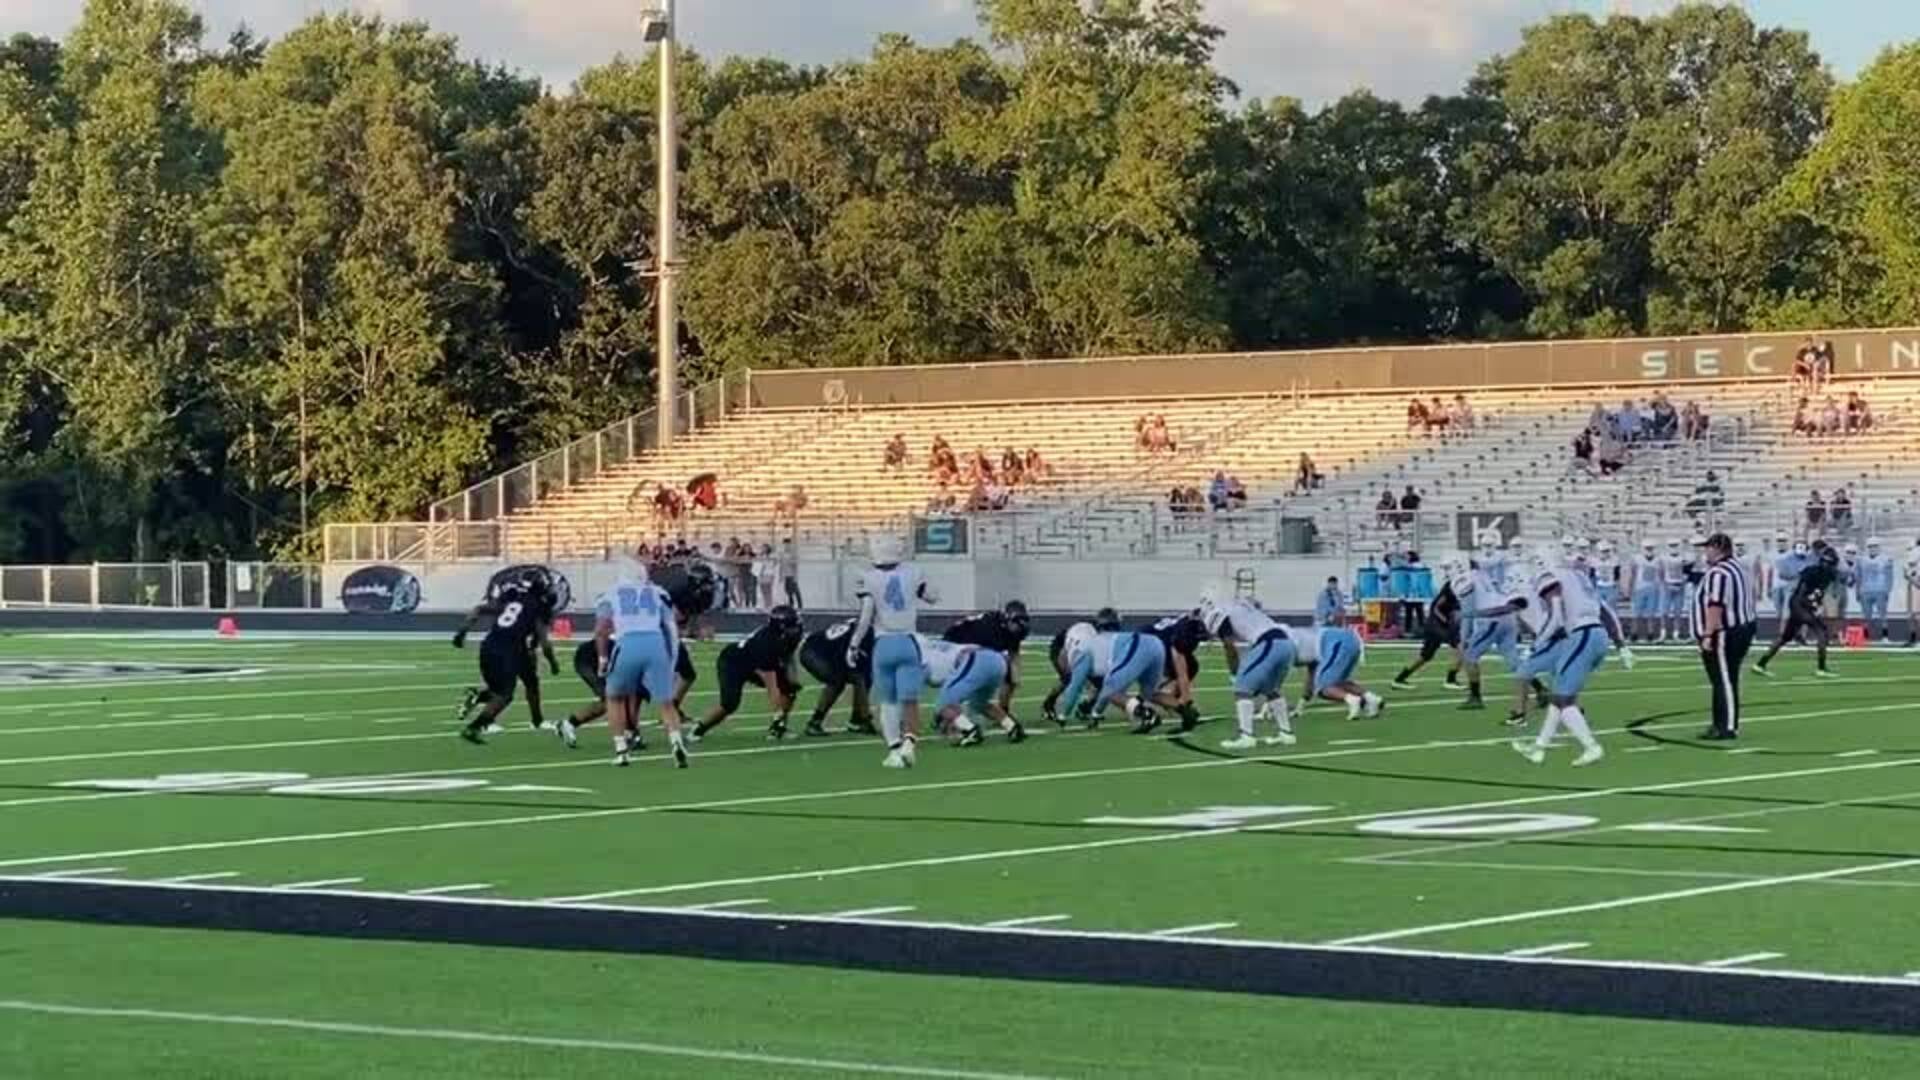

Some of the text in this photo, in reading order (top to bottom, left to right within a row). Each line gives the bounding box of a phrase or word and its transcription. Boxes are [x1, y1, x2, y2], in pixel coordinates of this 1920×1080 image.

[925, 521, 954, 551] S
[884, 575, 905, 609] 4
[497, 601, 523, 628] 8
